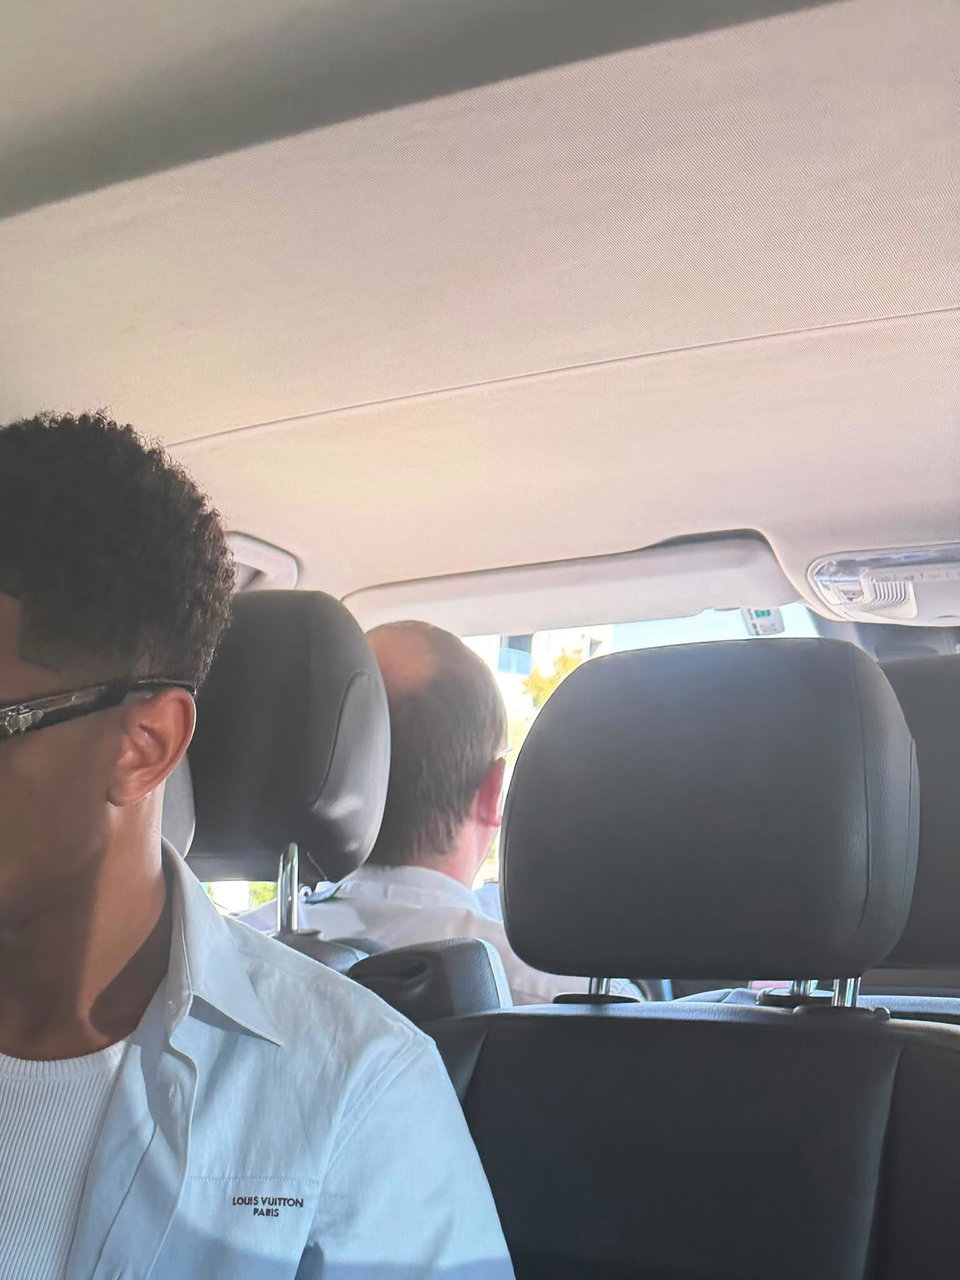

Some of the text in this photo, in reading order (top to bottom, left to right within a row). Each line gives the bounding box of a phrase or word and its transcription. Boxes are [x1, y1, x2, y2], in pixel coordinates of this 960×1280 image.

[232, 1196, 304, 1208] LOUIS VUITTON
[253, 1207, 280, 1217] PARIS
